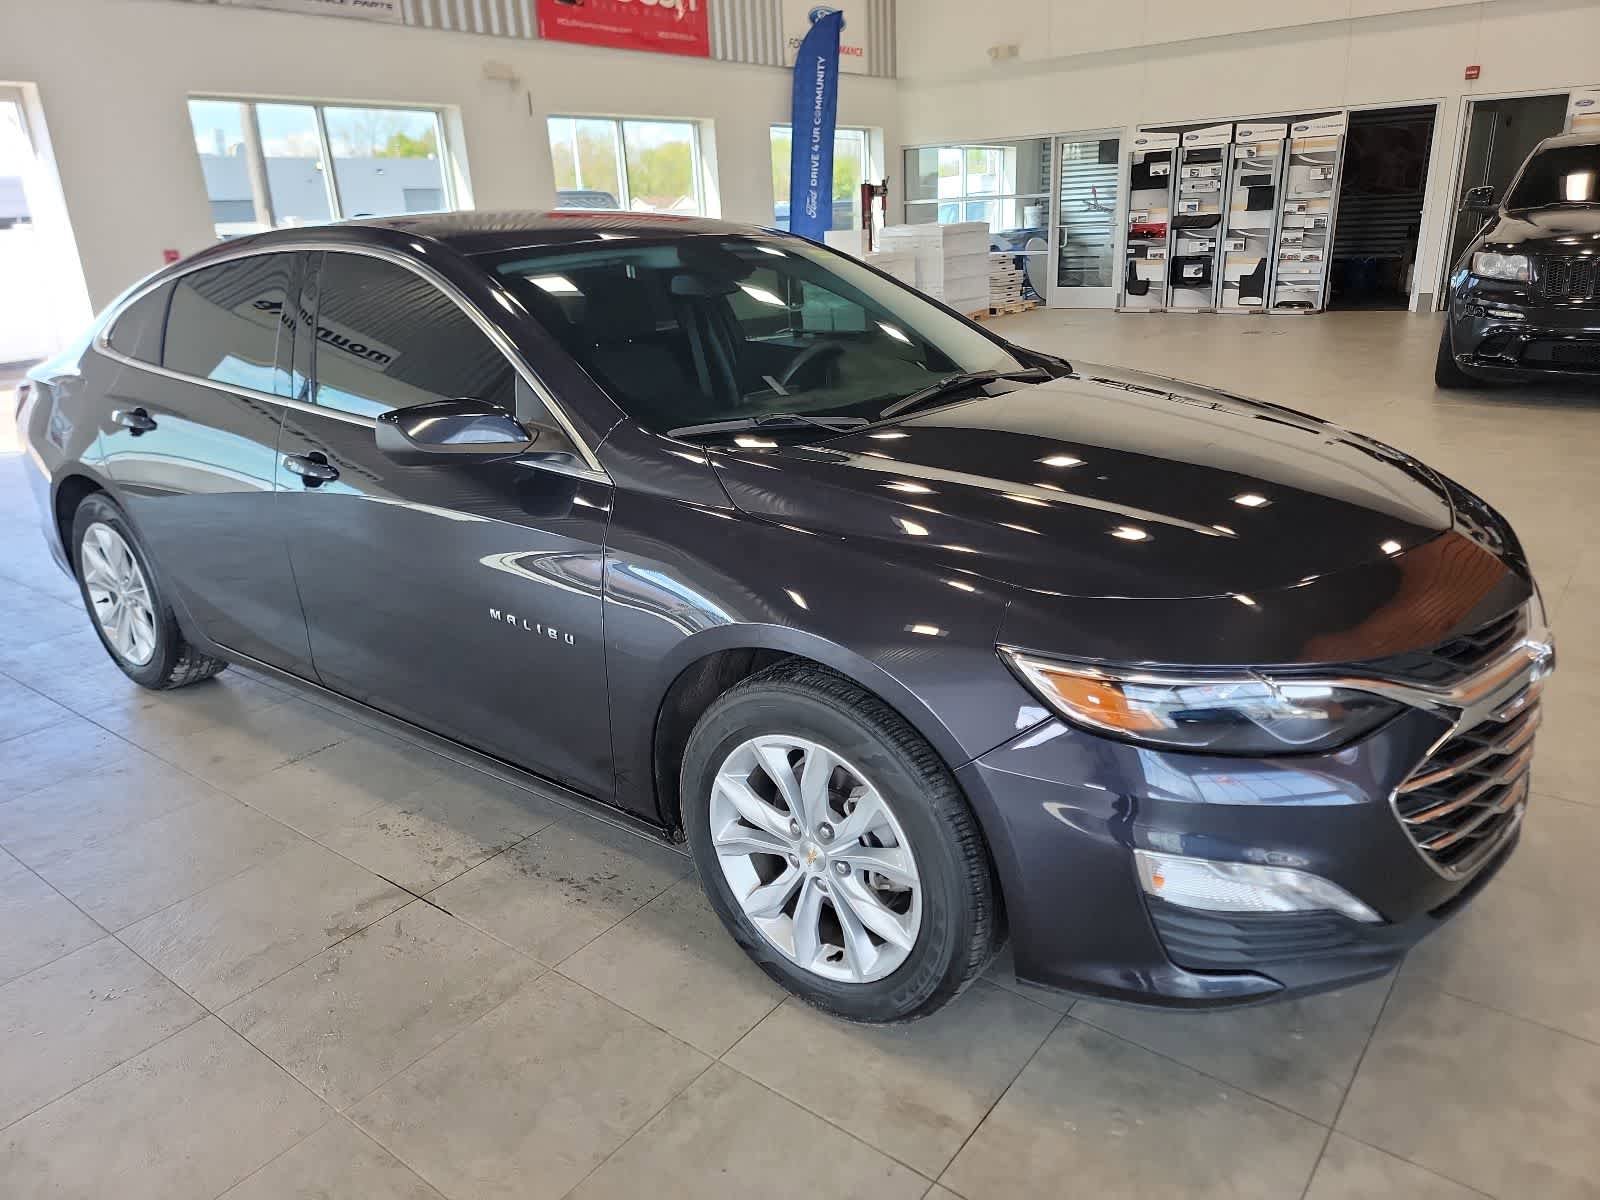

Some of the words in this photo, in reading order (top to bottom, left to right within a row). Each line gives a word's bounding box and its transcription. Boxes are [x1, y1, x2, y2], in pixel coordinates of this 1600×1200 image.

[813, 56, 827, 125] COMMUNITY
[811, 143, 820, 152] 4
[812, 127, 821, 143] UR
[810, 153, 820, 187] DRIVE
[806, 190, 818, 219] Ford
[489, 608, 575, 645] MALIBU
